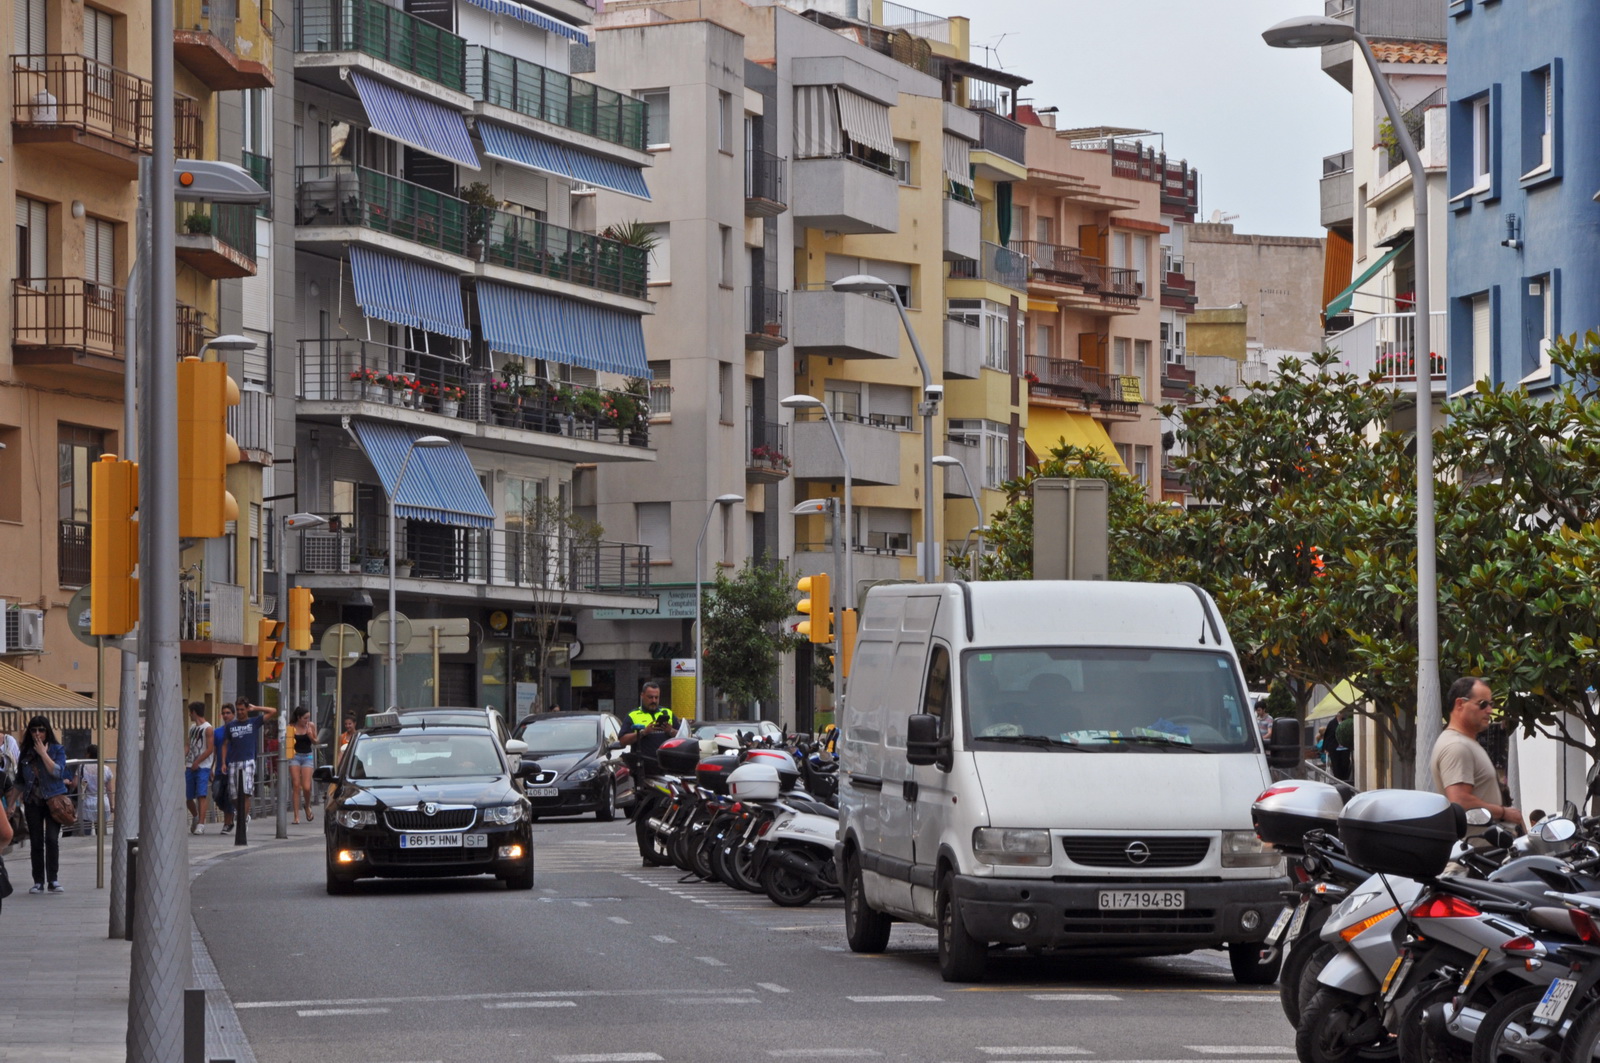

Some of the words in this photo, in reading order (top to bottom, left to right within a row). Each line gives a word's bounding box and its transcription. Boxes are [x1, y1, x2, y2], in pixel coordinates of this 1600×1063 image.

[409, 836, 436, 846] 6615
[439, 834, 458, 845] HNM
[1551, 982, 1574, 1000] 2373
[1541, 999, 1561, 1016] FZV
